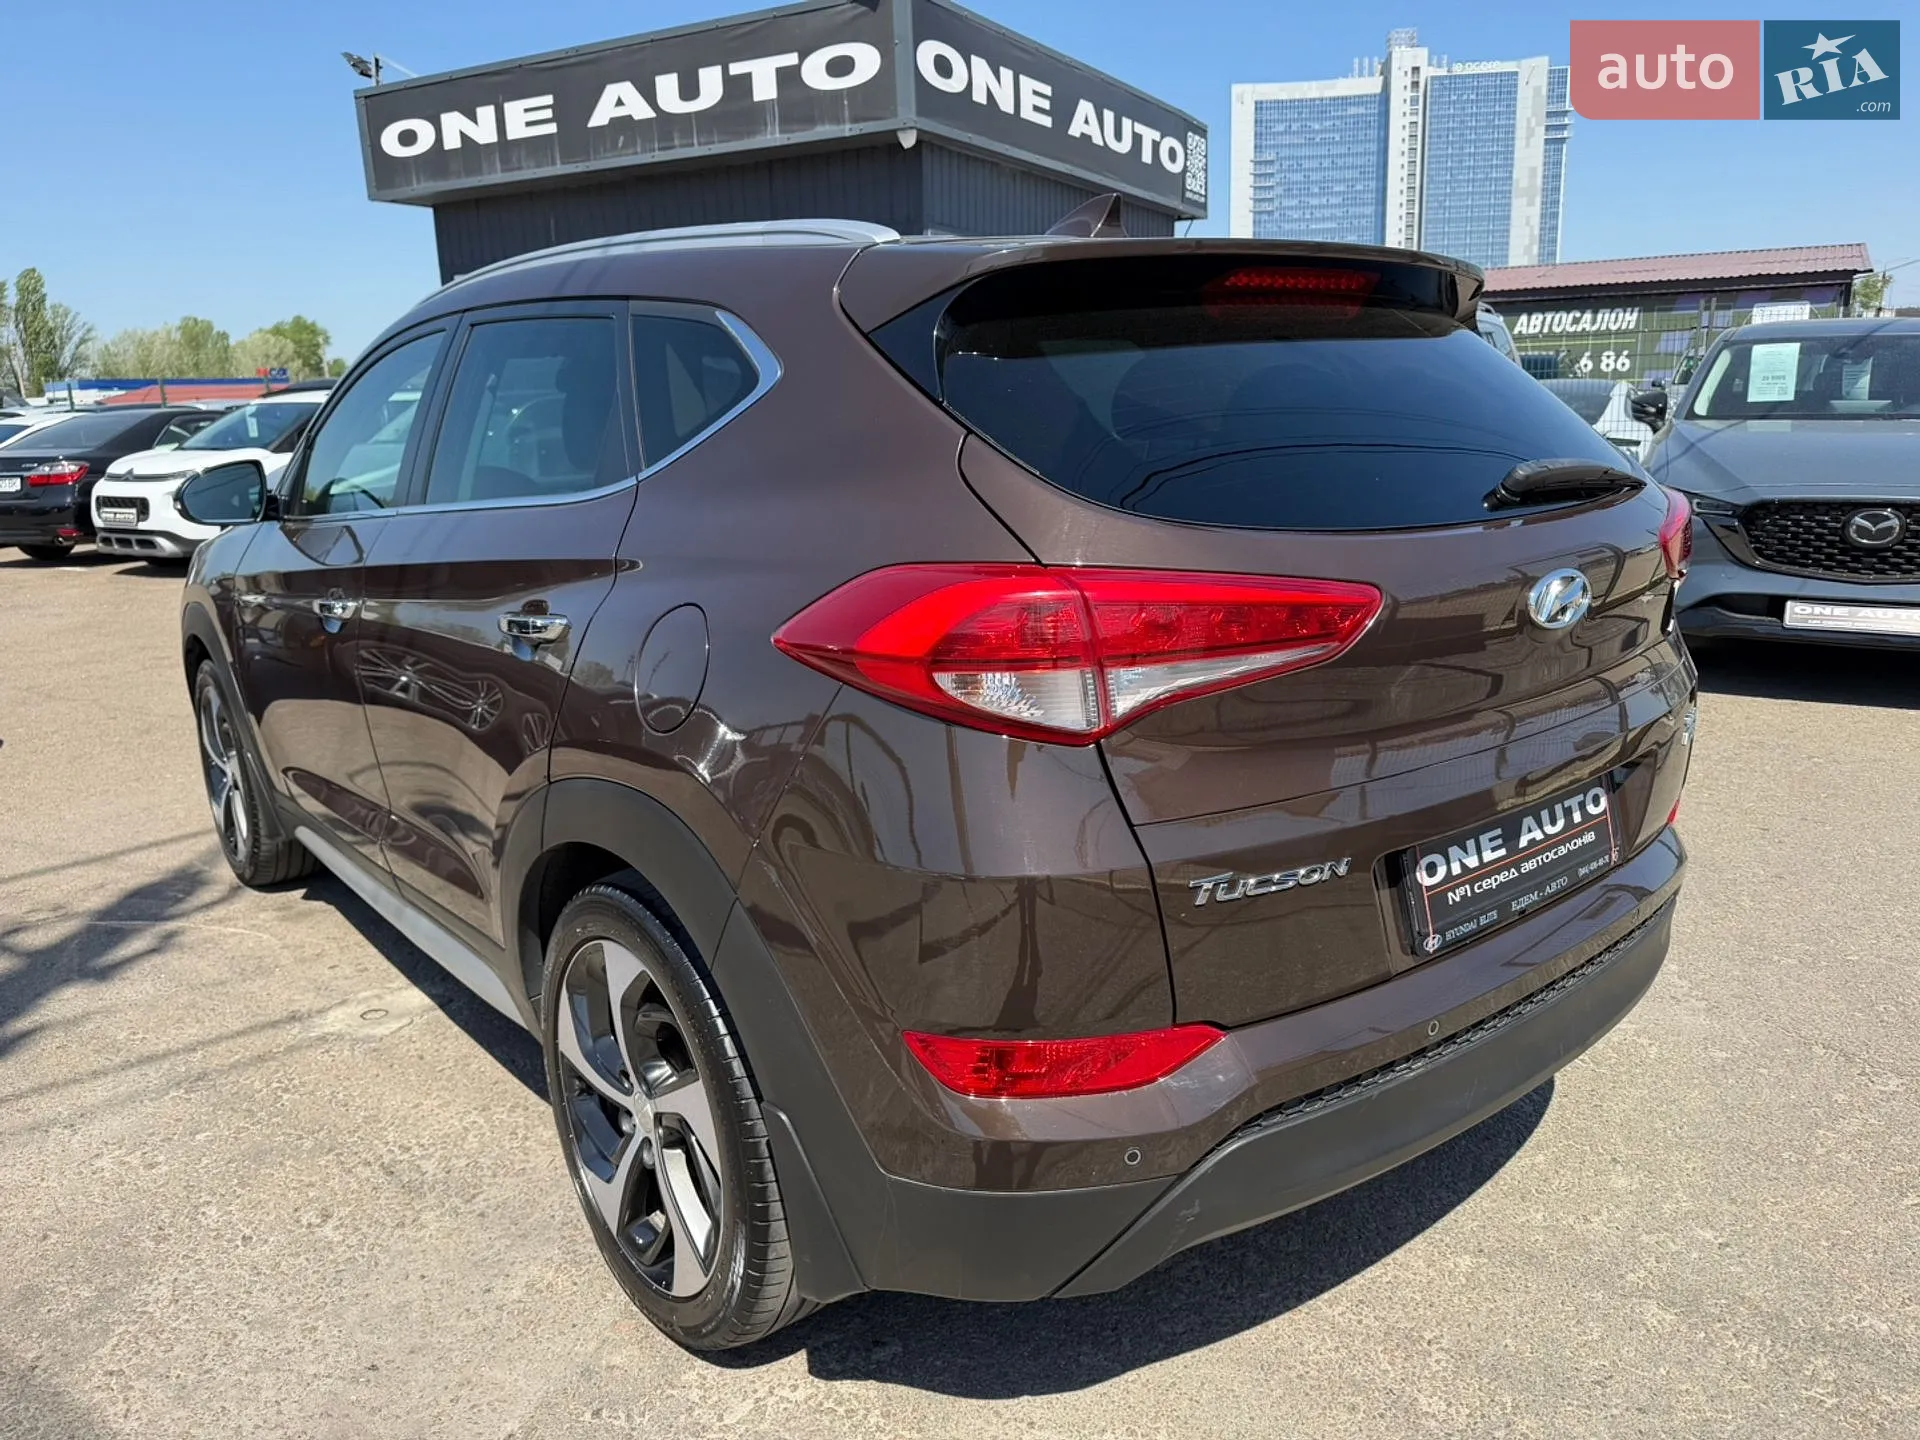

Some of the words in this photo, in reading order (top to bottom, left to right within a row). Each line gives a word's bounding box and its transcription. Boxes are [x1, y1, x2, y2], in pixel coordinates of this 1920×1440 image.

[380, 94, 558, 159] ONE
[587, 42, 882, 129] AUTO
[915, 38, 1054, 129] ONE
[1066, 98, 1186, 175] AUTO
[1512, 307, 1640, 335] АВТОСАЛОН
[1599, 349, 1631, 373] 86
[1793, 605, 1849, 617] ONE
[1415, 827, 1507, 887] ONE
[1518, 786, 1608, 849] AUTO
[1447, 884, 1472, 905] №1
[1473, 867, 1519, 893] серед
[1520, 830, 1596, 874] автосалонів
